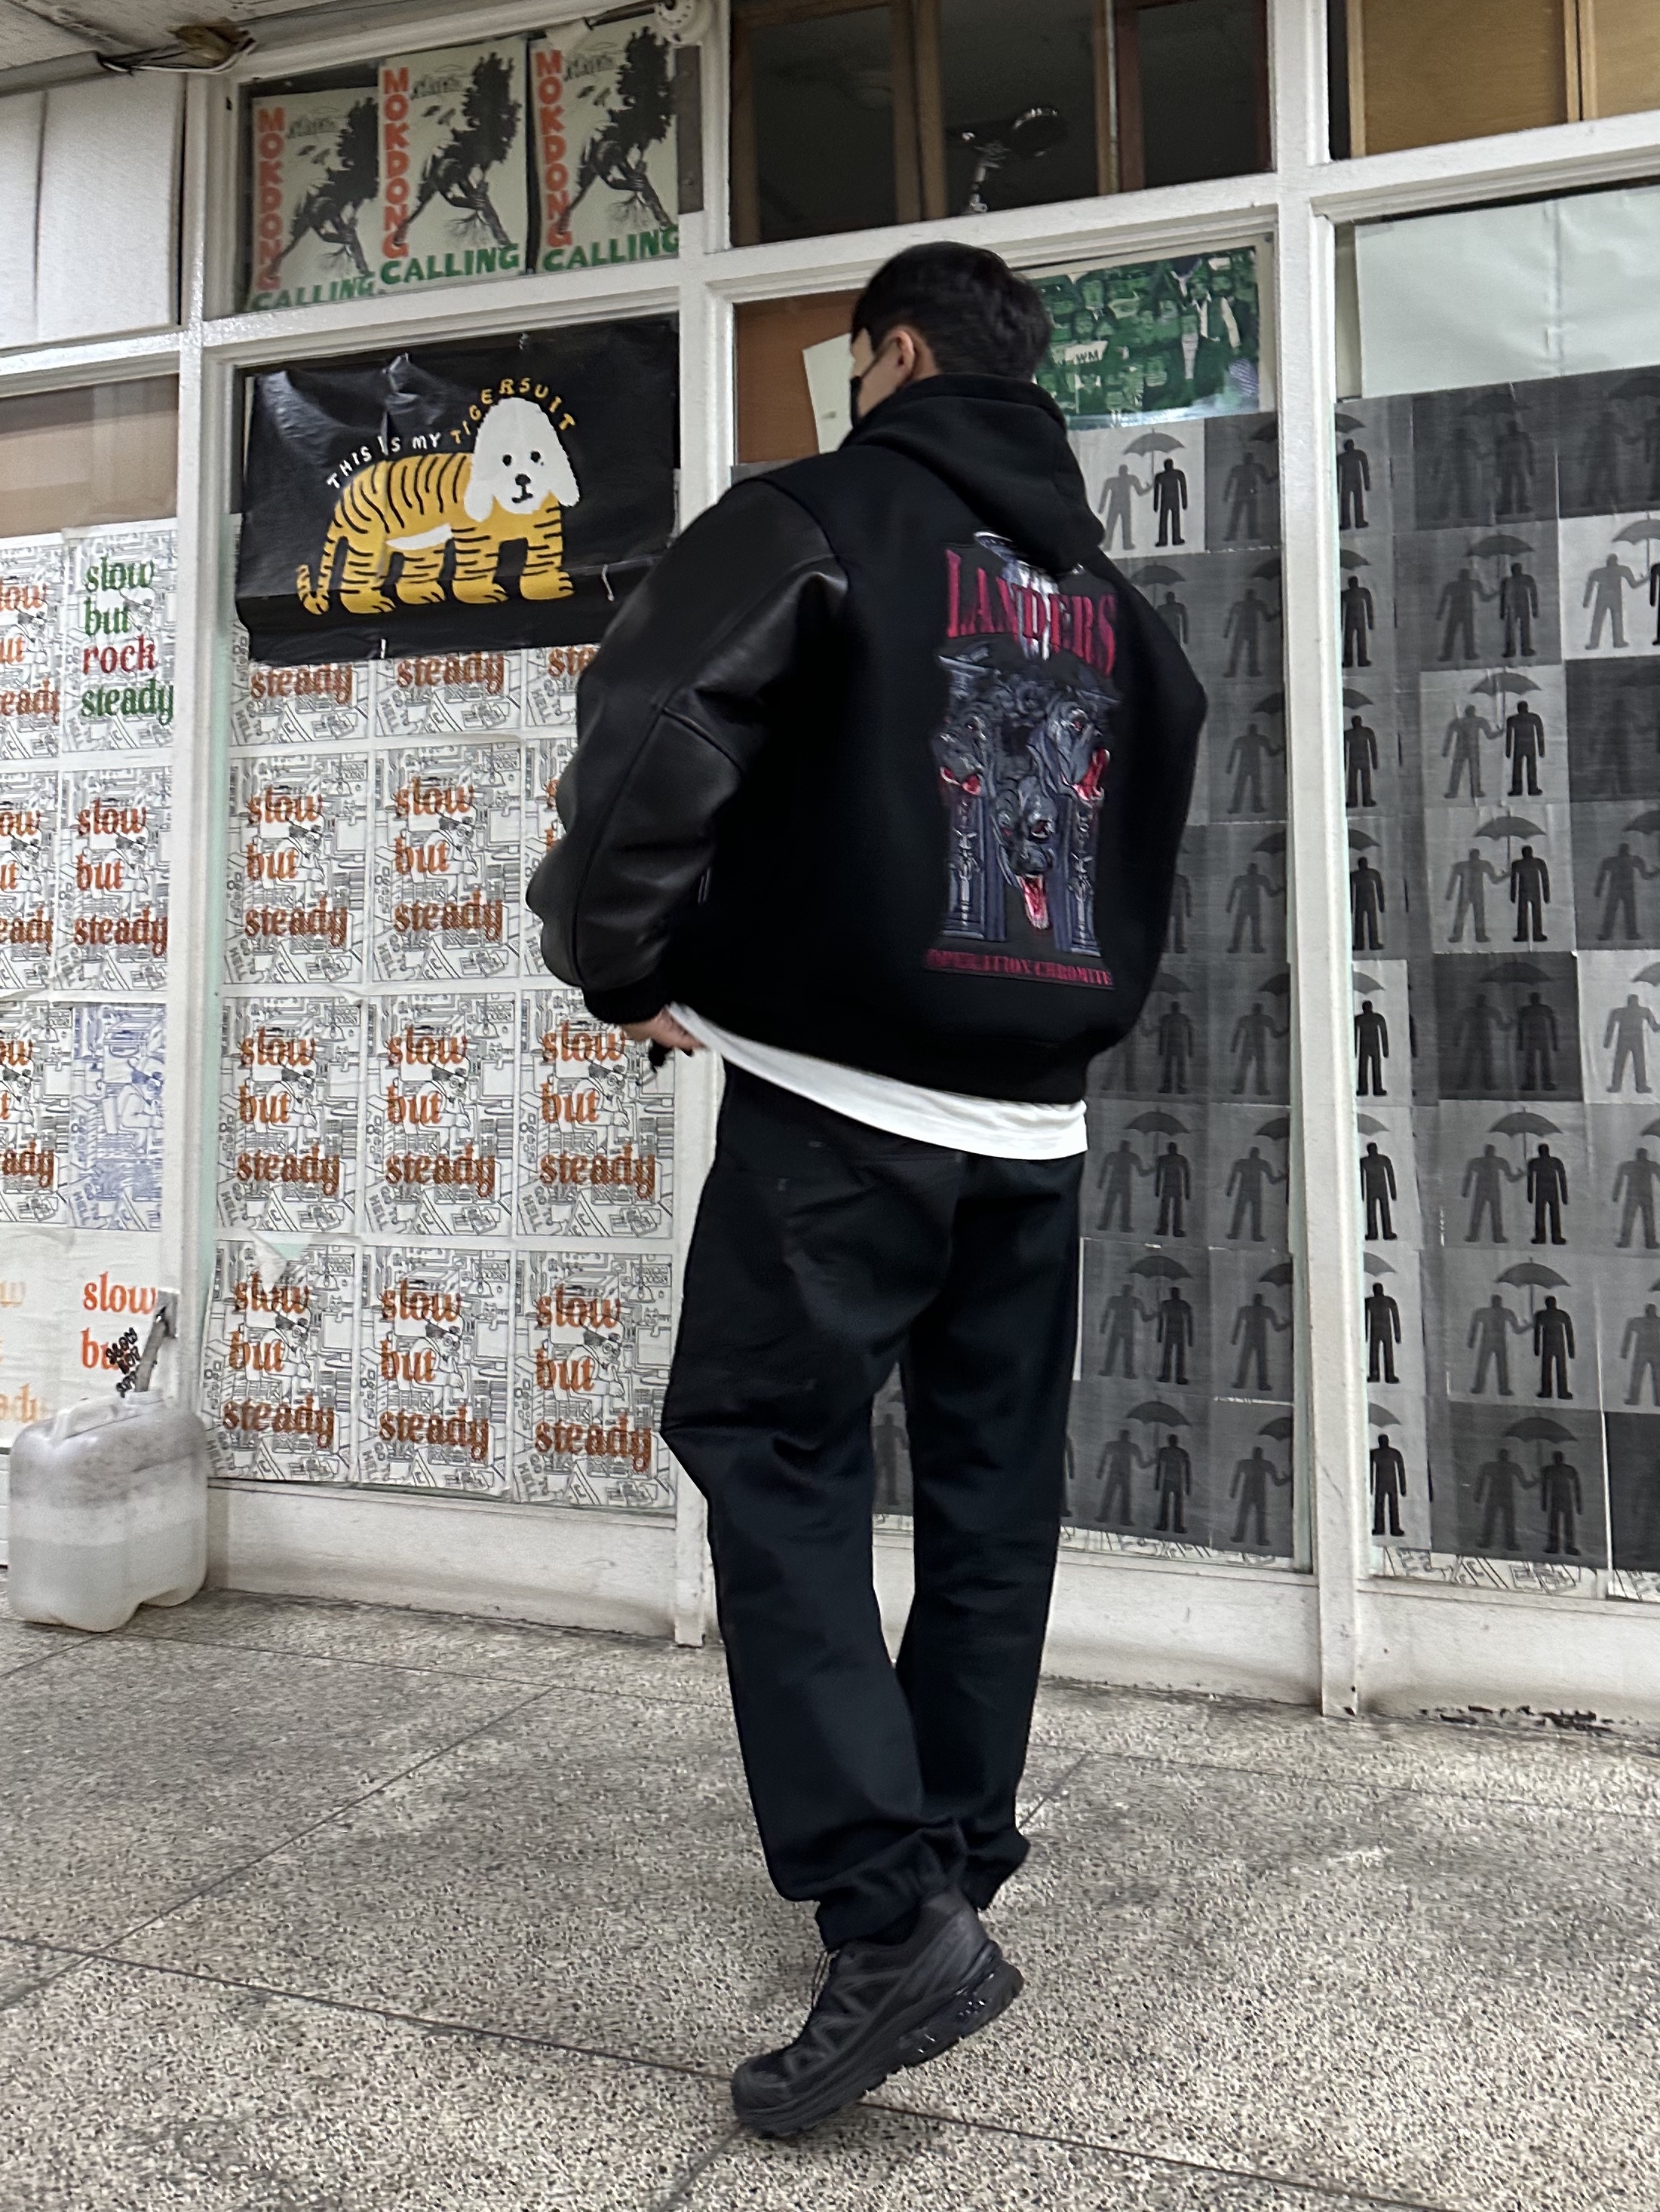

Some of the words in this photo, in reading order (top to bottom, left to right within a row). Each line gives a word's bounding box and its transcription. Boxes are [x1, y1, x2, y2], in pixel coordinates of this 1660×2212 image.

[382, 67, 410, 259] MOKDONG
[535, 49, 572, 247] MOKDONG
[380, 245, 520, 285] CALLING
[543, 227, 678, 272] CALLING
[326, 446, 372, 489] THIS
[378, 436, 401, 456] IS
[412, 431, 441, 450] MY
[85, 556, 155, 591] slow
[84, 596, 132, 636] but
[83, 634, 156, 675] rock
[397, 649, 504, 695] steady
[80, 677, 173, 726] steady
[78, 796, 146, 836] slow
[248, 785, 323, 824] slow
[395, 777, 474, 818] slow
[76, 853, 124, 891] but
[246, 842, 299, 881] but
[394, 831, 450, 875] but
[74, 904, 168, 956] steady
[244, 894, 348, 947] steady
[393, 887, 503, 942] steady
[241, 1026, 316, 1066] slow
[387, 1023, 468, 1066] slow
[542, 1020, 625, 1063] slow
[238, 1084, 291, 1124] but
[387, 1084, 443, 1125] but
[540, 1081, 600, 1124] but
[237, 1141, 340, 1198] steady
[385, 1141, 496, 1199] steady
[539, 1141, 655, 1200] steady
[83, 1271, 158, 1315] slow
[233, 1269, 311, 1316] slow
[381, 1276, 462, 1323] slow
[535, 1282, 621, 1330] slow
[229, 1329, 285, 1373] but
[379, 1337, 437, 1384] but
[535, 1345, 596, 1393] but
[223, 1393, 336, 1449] steady
[379, 1403, 489, 1463] steady
[535, 1412, 652, 1474] steady
